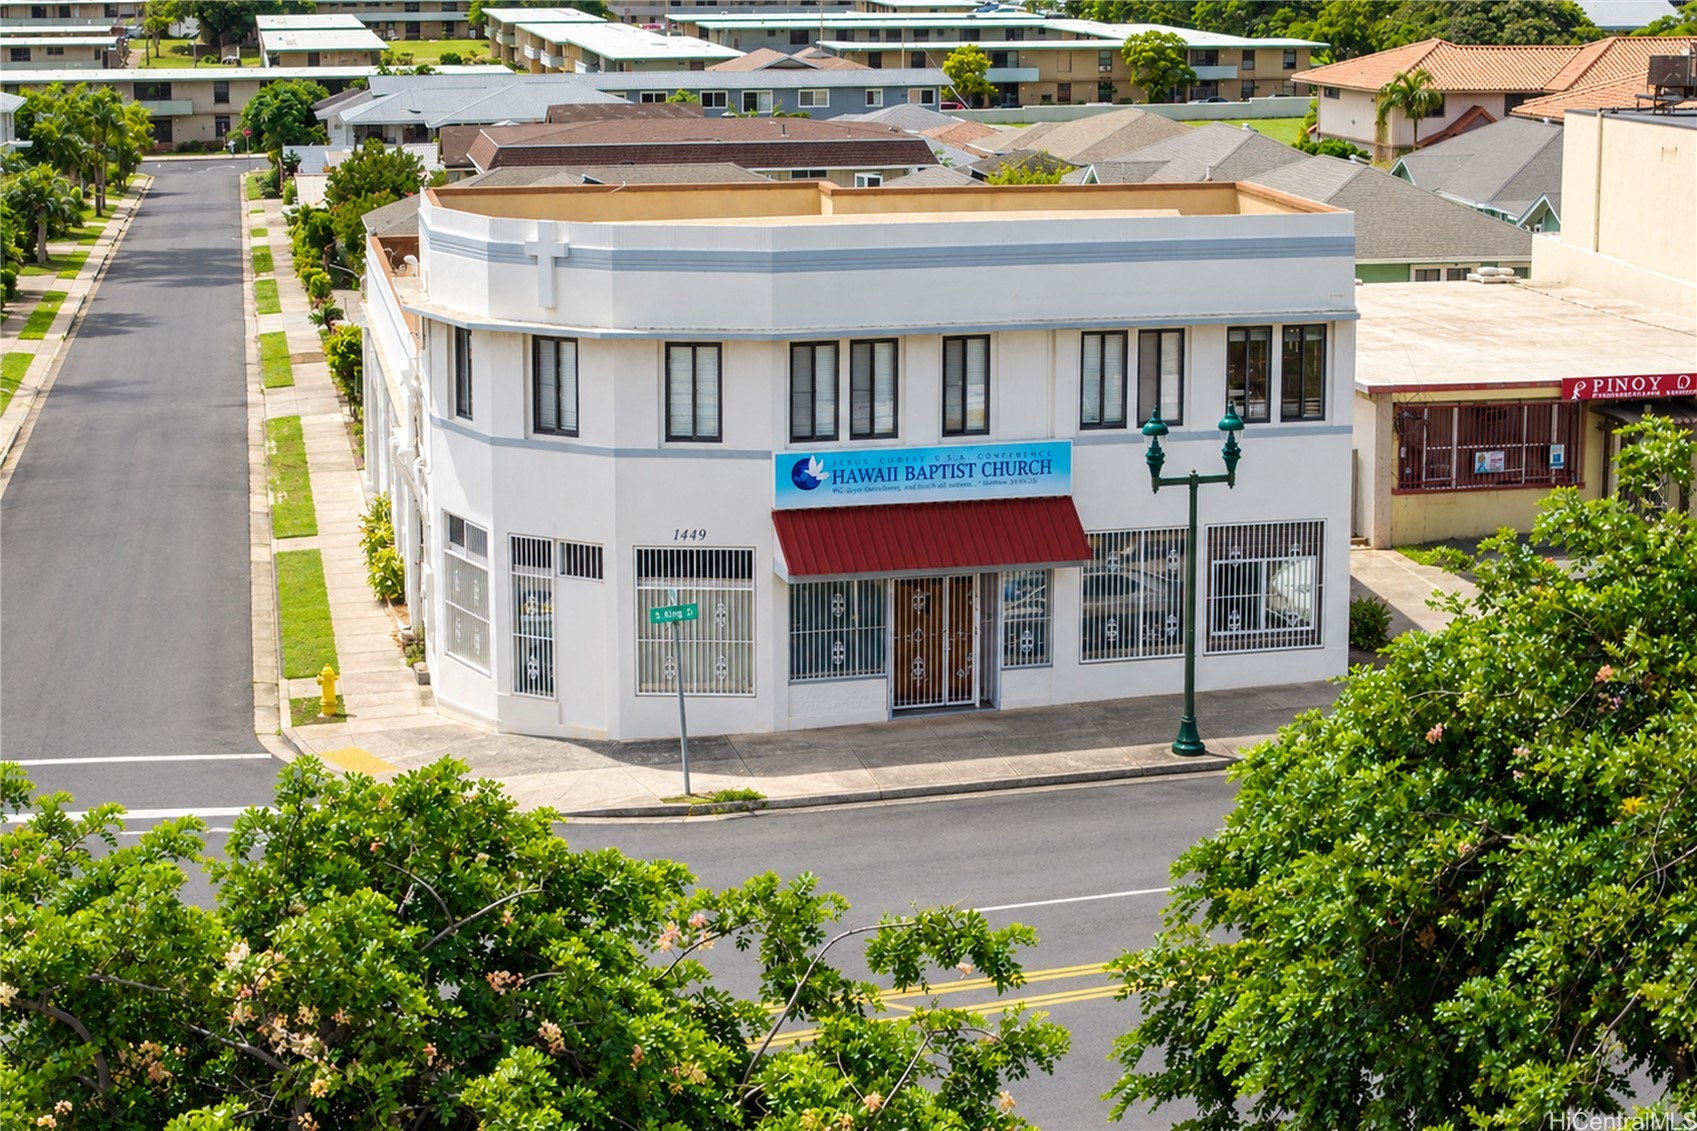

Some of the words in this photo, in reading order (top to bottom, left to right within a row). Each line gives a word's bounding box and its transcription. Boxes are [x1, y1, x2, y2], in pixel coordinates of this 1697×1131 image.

[1593, 376, 1662, 393] PINOY
[832, 466, 898, 485] HAWAII
[905, 462, 977, 481] BAPTIST
[981, 459, 1053, 478] CHURCH
[673, 528, 707, 541] 1449
